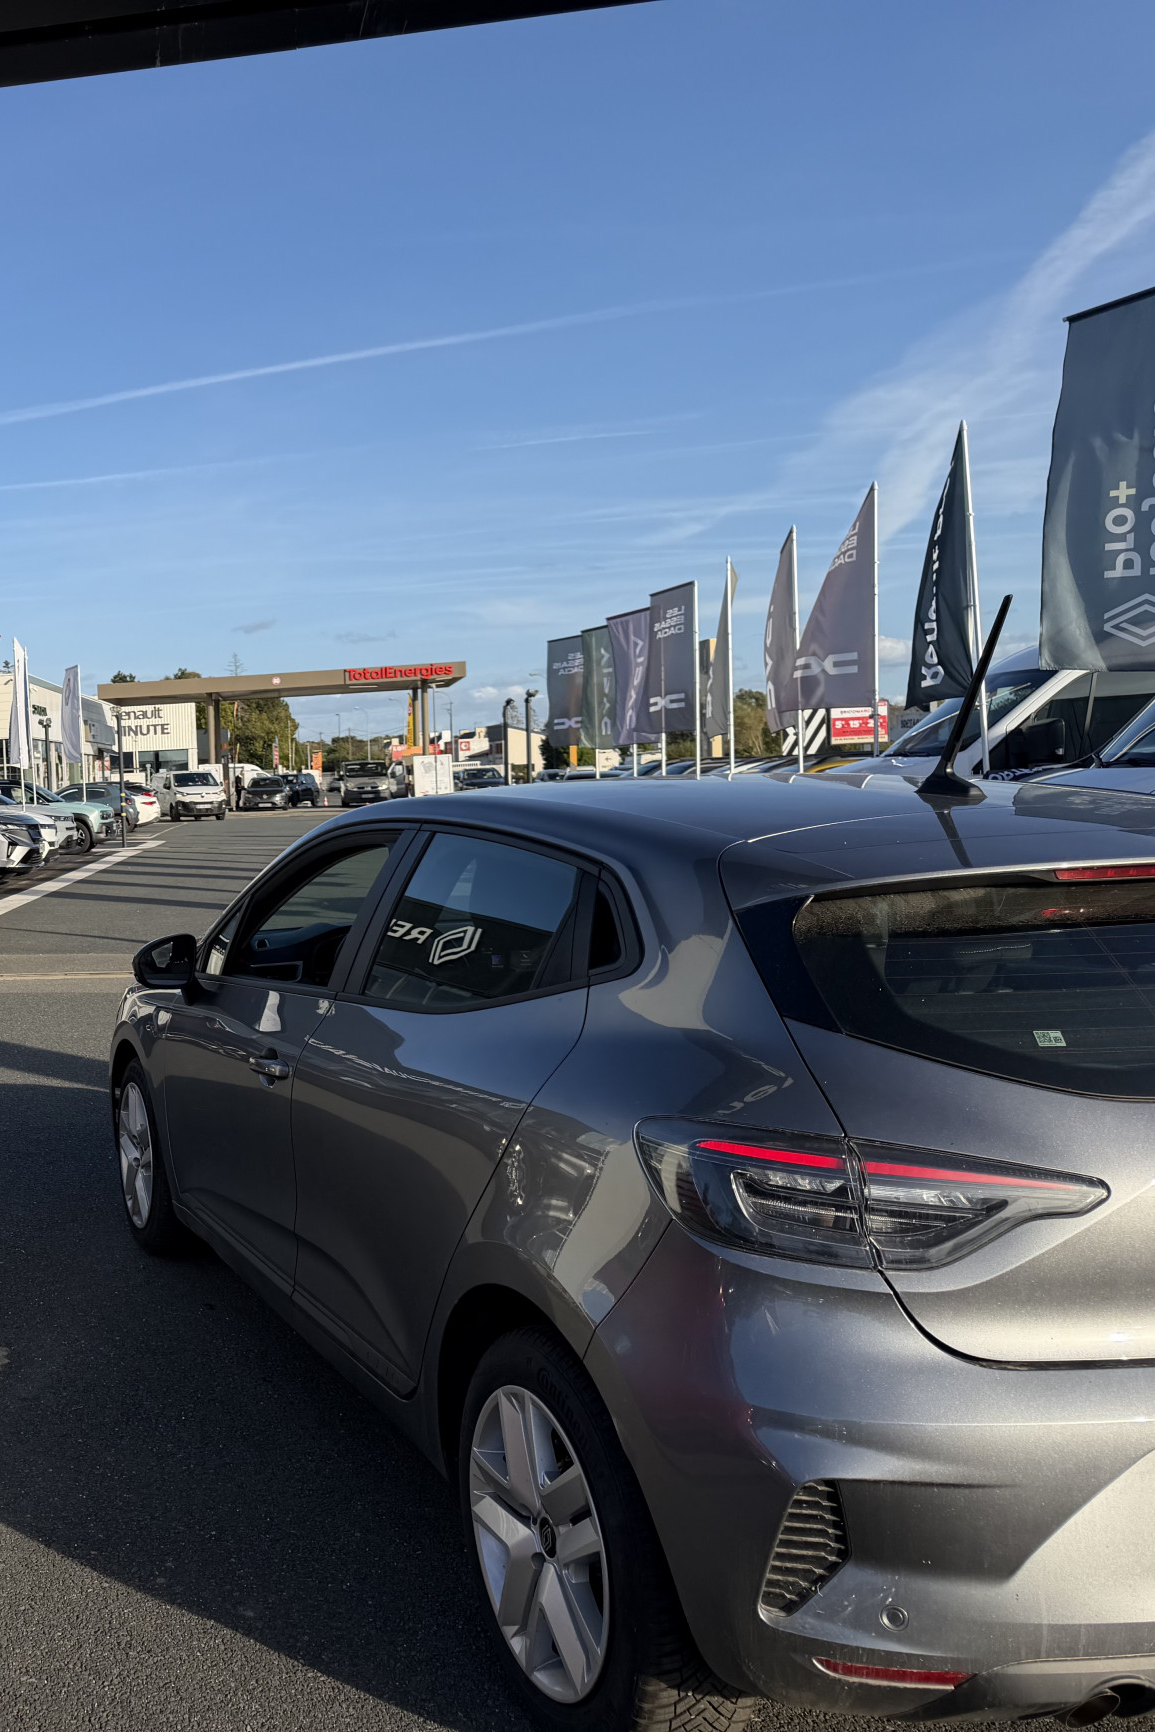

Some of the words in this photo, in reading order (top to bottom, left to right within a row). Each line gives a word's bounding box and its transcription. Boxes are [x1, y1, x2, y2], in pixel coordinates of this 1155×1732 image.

[346, 663, 454, 681] TotalEnergies
[114, 707, 163, 721] enault
[116, 723, 171, 737] INUTE
